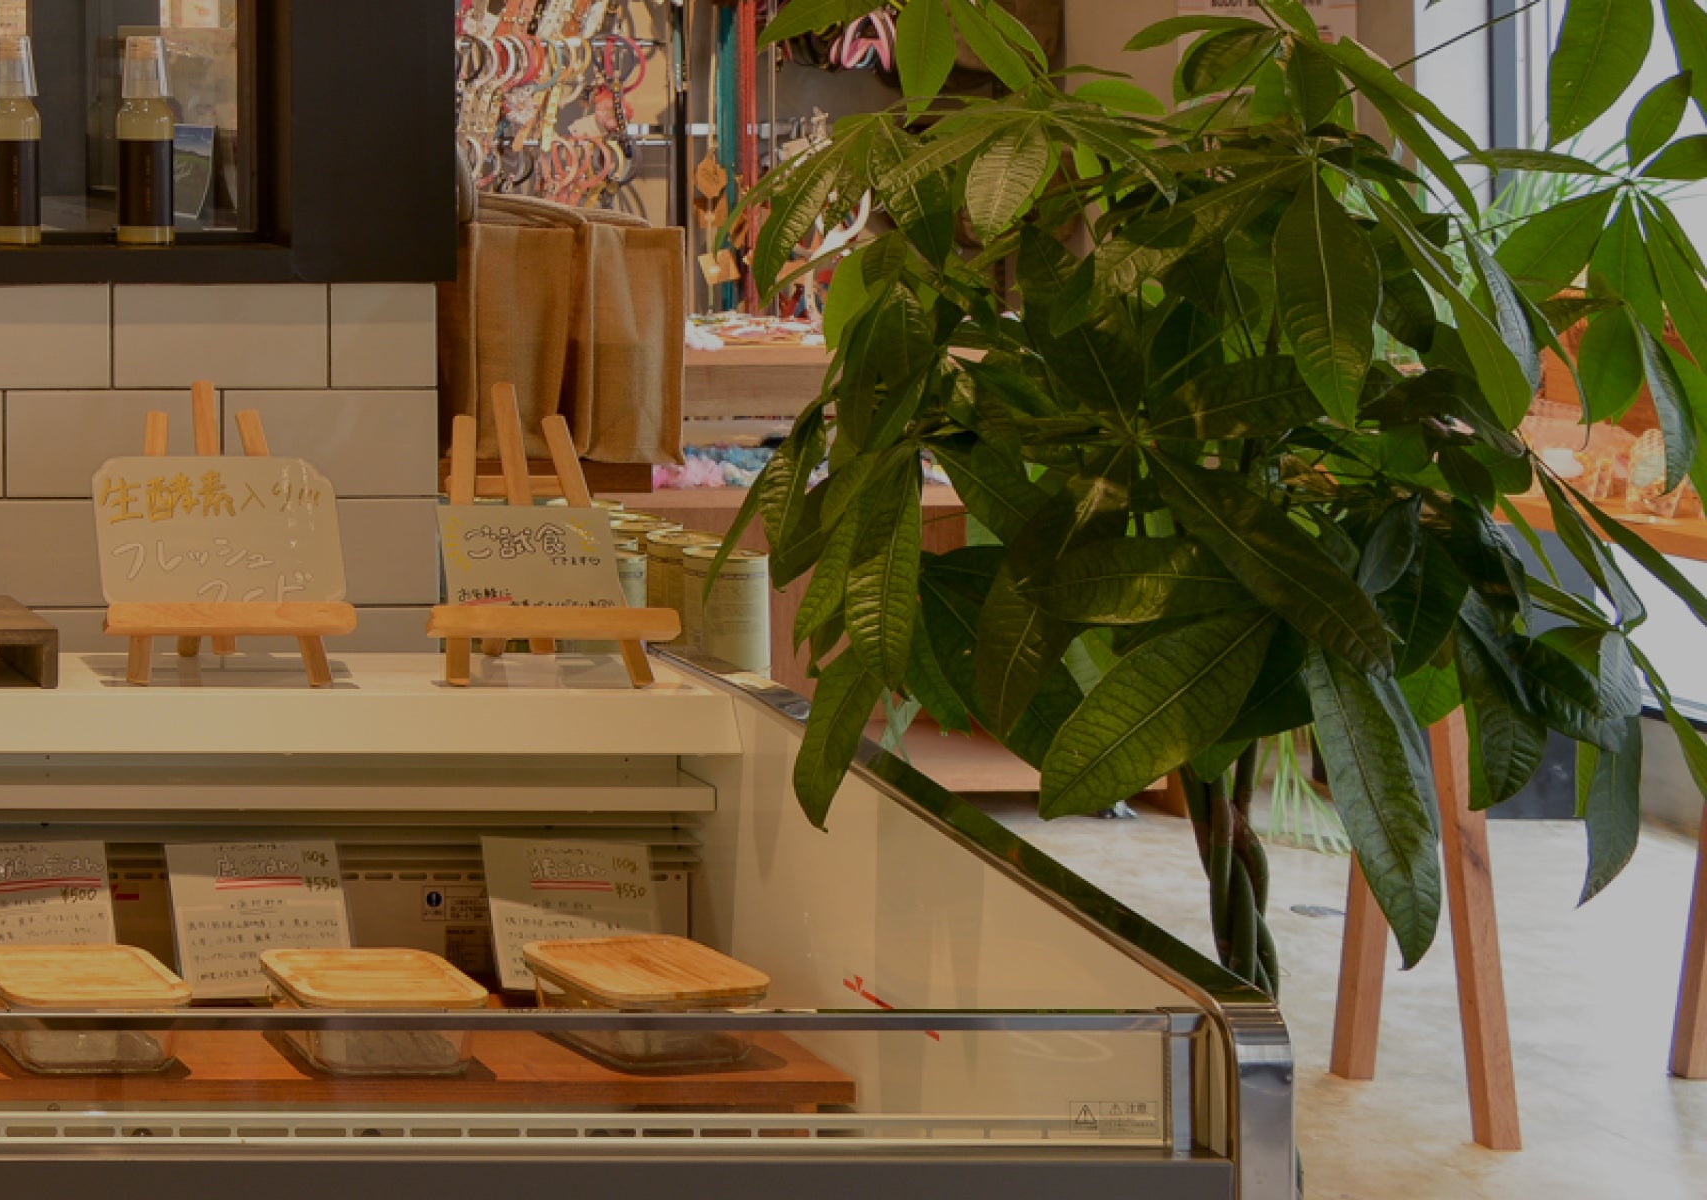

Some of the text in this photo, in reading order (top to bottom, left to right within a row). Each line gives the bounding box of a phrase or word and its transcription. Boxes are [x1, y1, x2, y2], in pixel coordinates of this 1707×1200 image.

[111, 538, 274, 580] フレッシュ
[464, 522, 567, 559] ご試食
